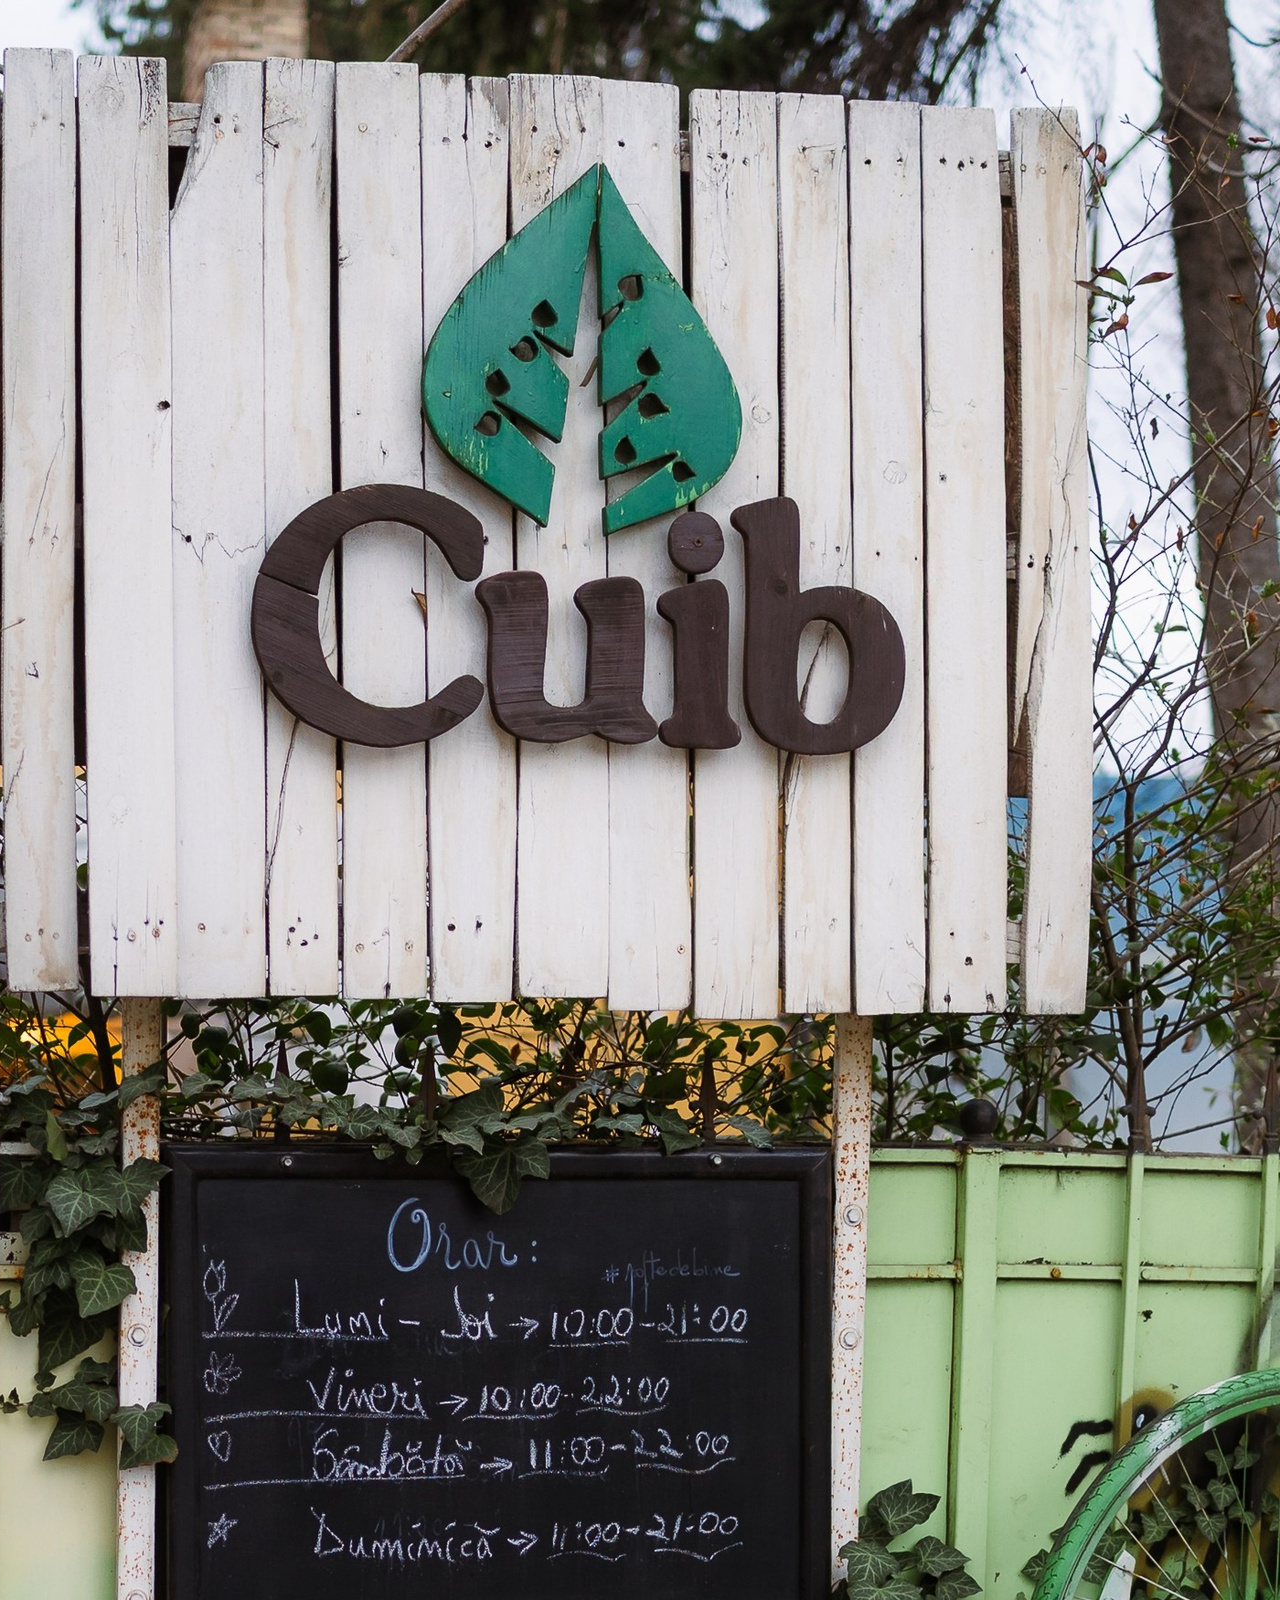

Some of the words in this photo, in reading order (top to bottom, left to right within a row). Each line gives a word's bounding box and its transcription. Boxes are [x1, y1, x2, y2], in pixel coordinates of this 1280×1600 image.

[251, 484, 906, 756] Cuib
[387, 1198, 538, 1273] Orar:
[306, 1366, 429, 1417] Vineri
